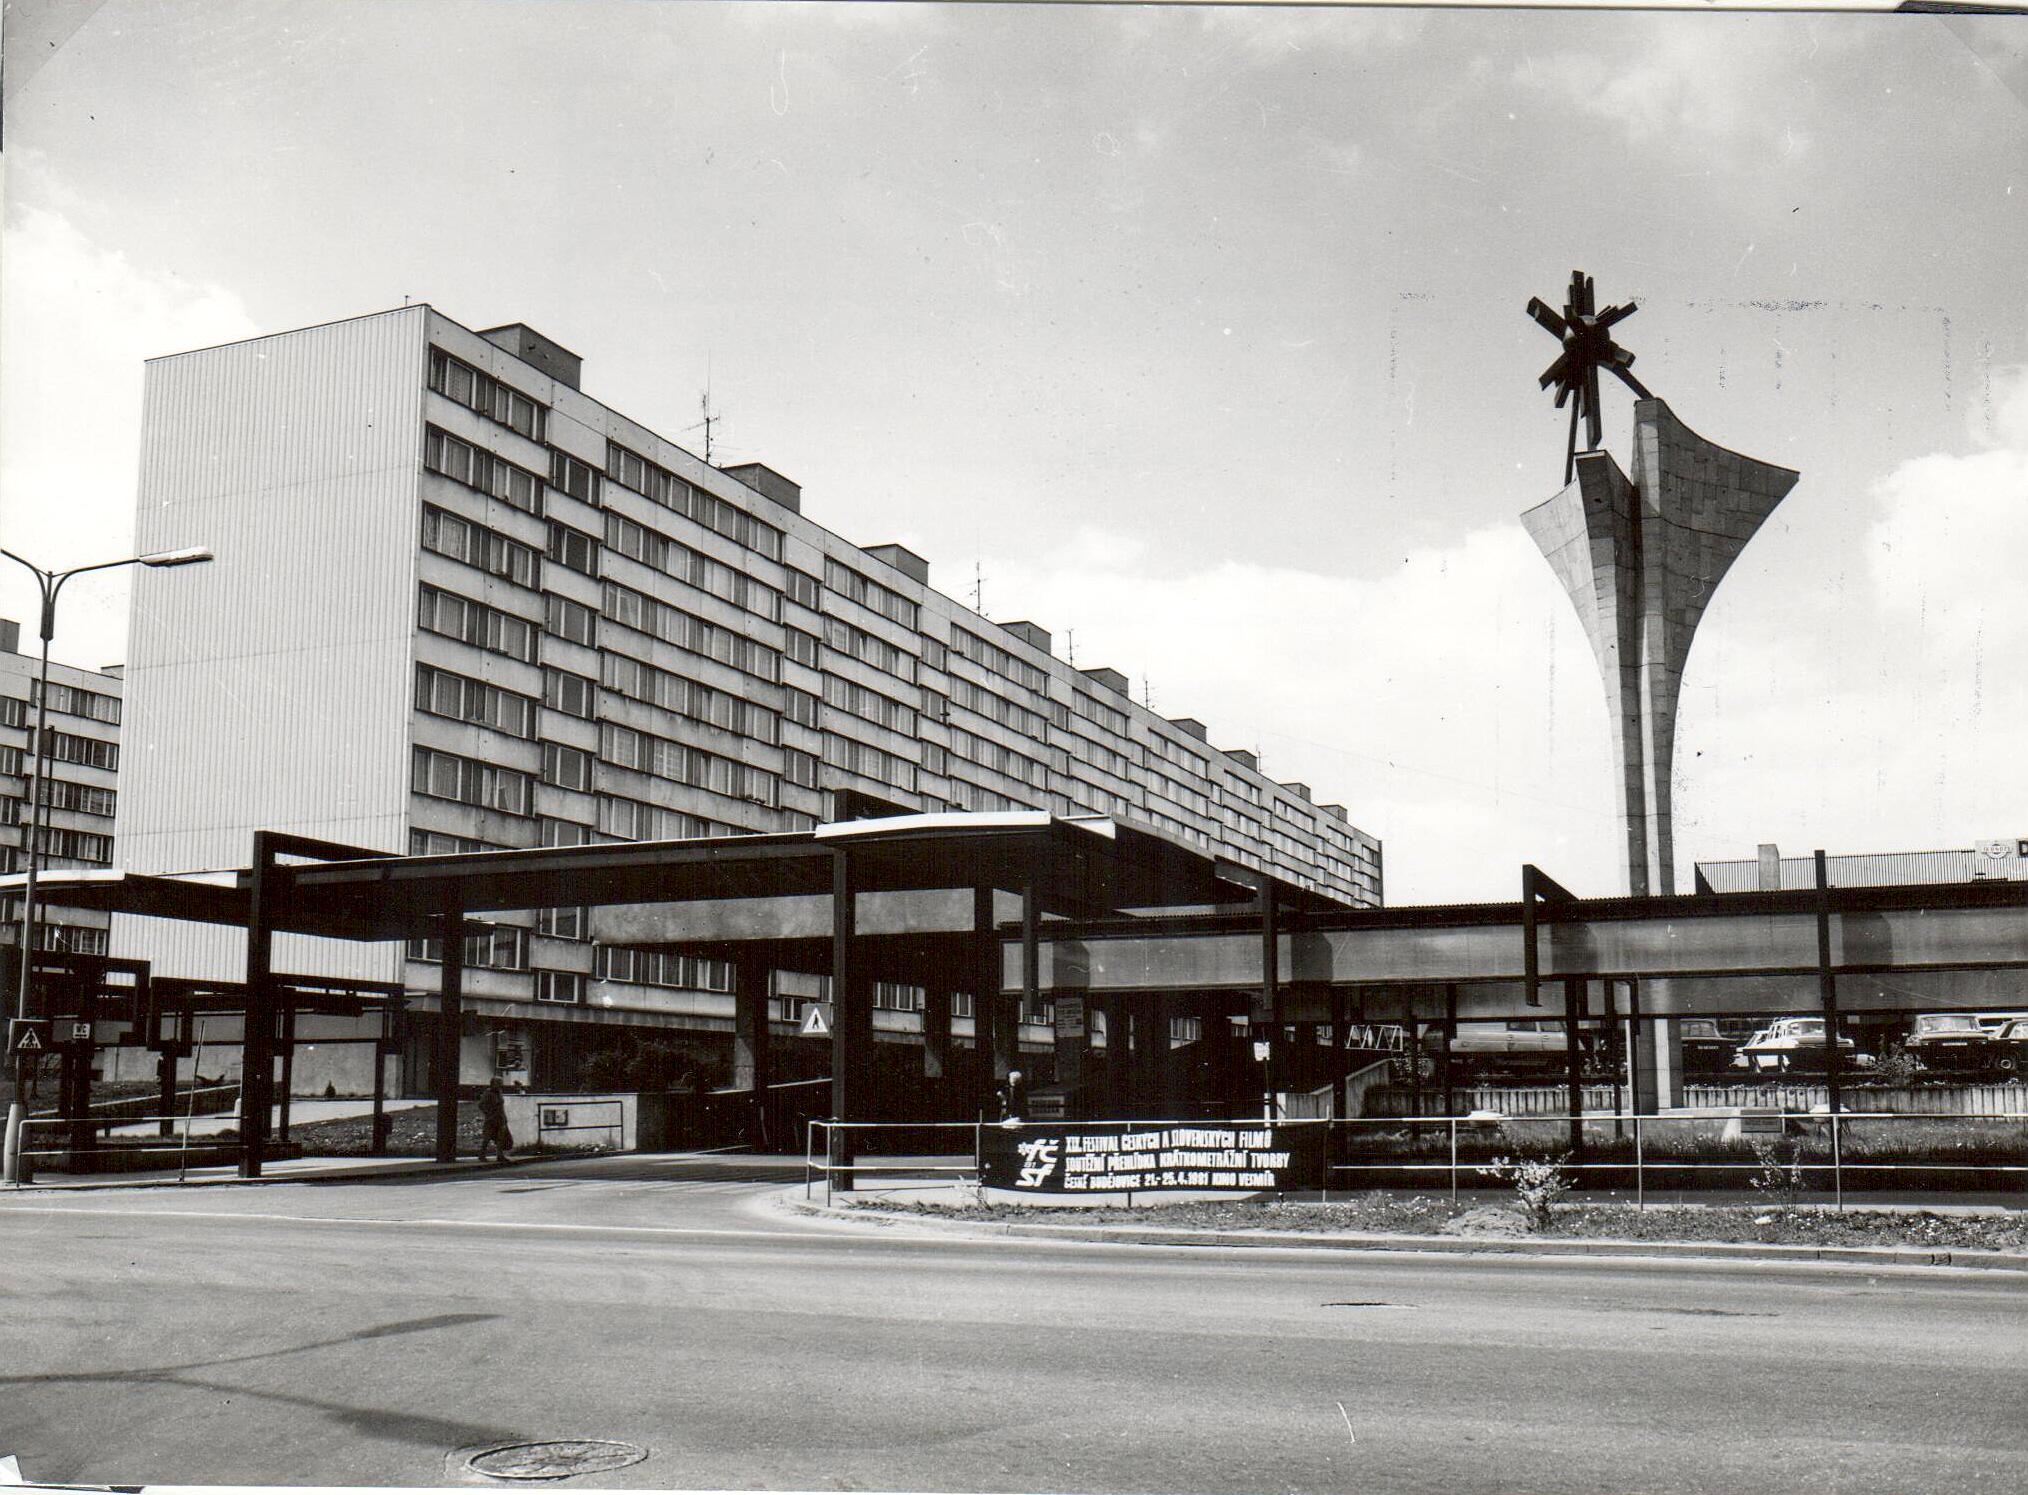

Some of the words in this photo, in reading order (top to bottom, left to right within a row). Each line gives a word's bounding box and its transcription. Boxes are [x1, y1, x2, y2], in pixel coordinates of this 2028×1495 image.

[1082, 1136, 1119, 1152] FESTIVAL
[1162, 1131, 1170, 1148] A
[1250, 1153, 1290, 1168] TVORBY
[1064, 1173, 1088, 1189] ČESKÉ
[1089, 1173, 1141, 1189] BUDĚJOVICE
[1212, 1172, 1236, 1186] KINO
